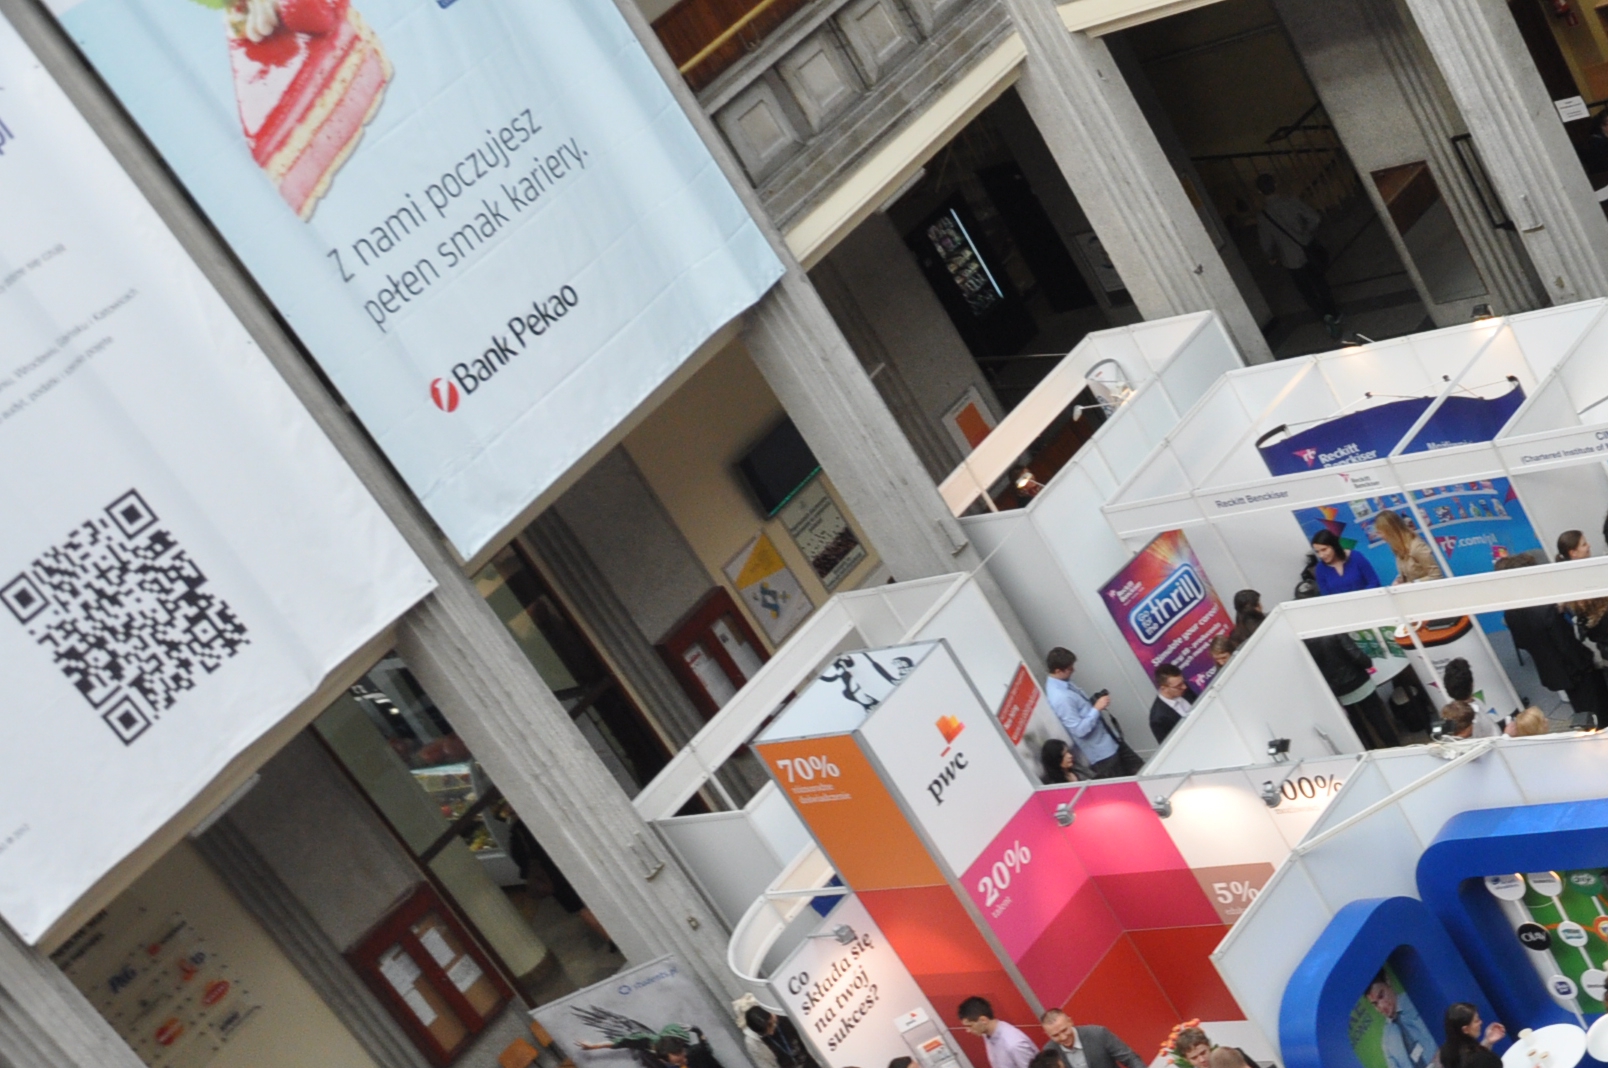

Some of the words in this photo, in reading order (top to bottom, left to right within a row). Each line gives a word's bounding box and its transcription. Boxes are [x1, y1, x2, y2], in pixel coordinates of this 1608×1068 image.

[327, 249, 355, 282] Z
[353, 193, 426, 265] nami
[424, 109, 542, 217] poczujesz
[364, 259, 440, 333] pełen
[437, 199, 509, 267] smak
[501, 138, 588, 212] kariery.
[452, 336, 518, 394] Bank
[508, 285, 578, 348] Pekao
[1319, 443, 1358, 464] Reckitt
[1521, 451, 1562, 465] (Chartered
[1562, 445, 1595, 458] Institute
[1596, 444, 1604, 452] of
[1215, 495, 1246, 508] Reckitt
[1248, 490, 1289, 504] Benckiser
[1147, 574, 1200, 624] thrill
[1181, 621, 1199, 641] your
[776, 755, 840, 782] 70%
[927, 751, 968, 806] pwc
[1281, 774, 1343, 801] 00%
[978, 840, 1031, 907] 20%
[1212, 881, 1259, 904] 5%
[788, 971, 809, 996] Co
[801, 957, 851, 1015] składa
[850, 933, 875, 960] się
[815, 1007, 836, 1034] na
[836, 965, 869, 1009] twój
[828, 984, 879, 1051] sukces?
